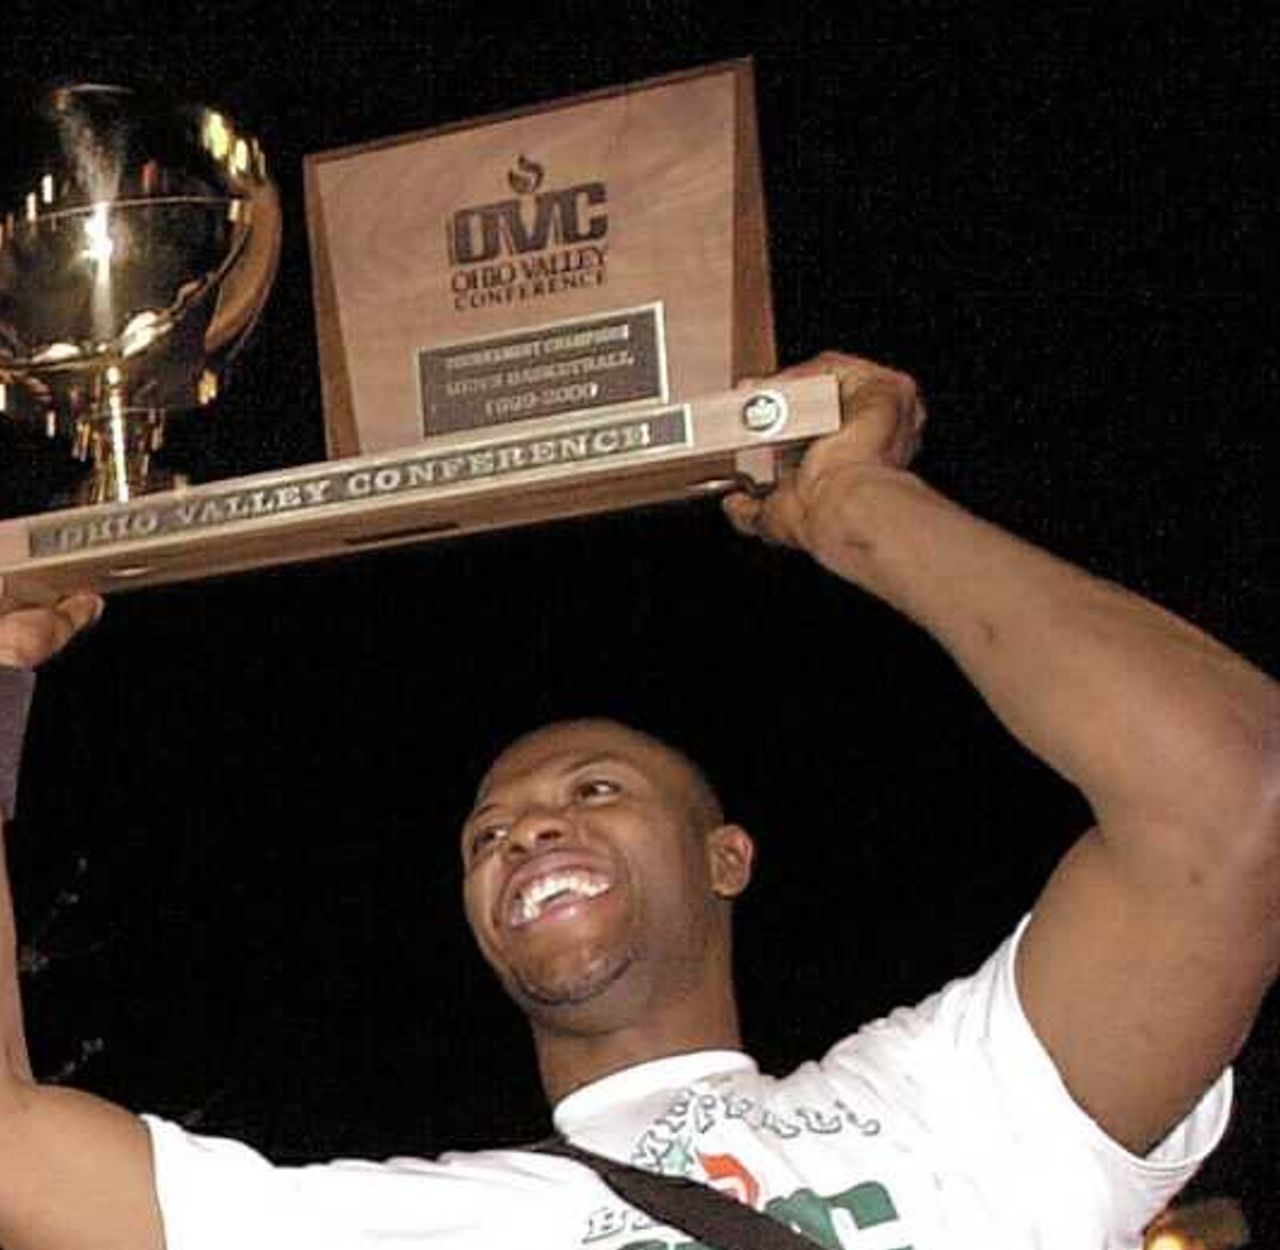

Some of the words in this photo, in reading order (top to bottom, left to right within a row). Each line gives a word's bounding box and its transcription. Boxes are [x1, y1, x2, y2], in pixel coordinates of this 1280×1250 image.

[446, 181, 608, 266] OVC
[451, 260, 516, 293] OHIO
[520, 246, 607, 282] VALLEY
[454, 268, 603, 311] CONFERENCE
[176, 479, 331, 526] VALLEY
[346, 422, 651, 496] CONFERENCE
